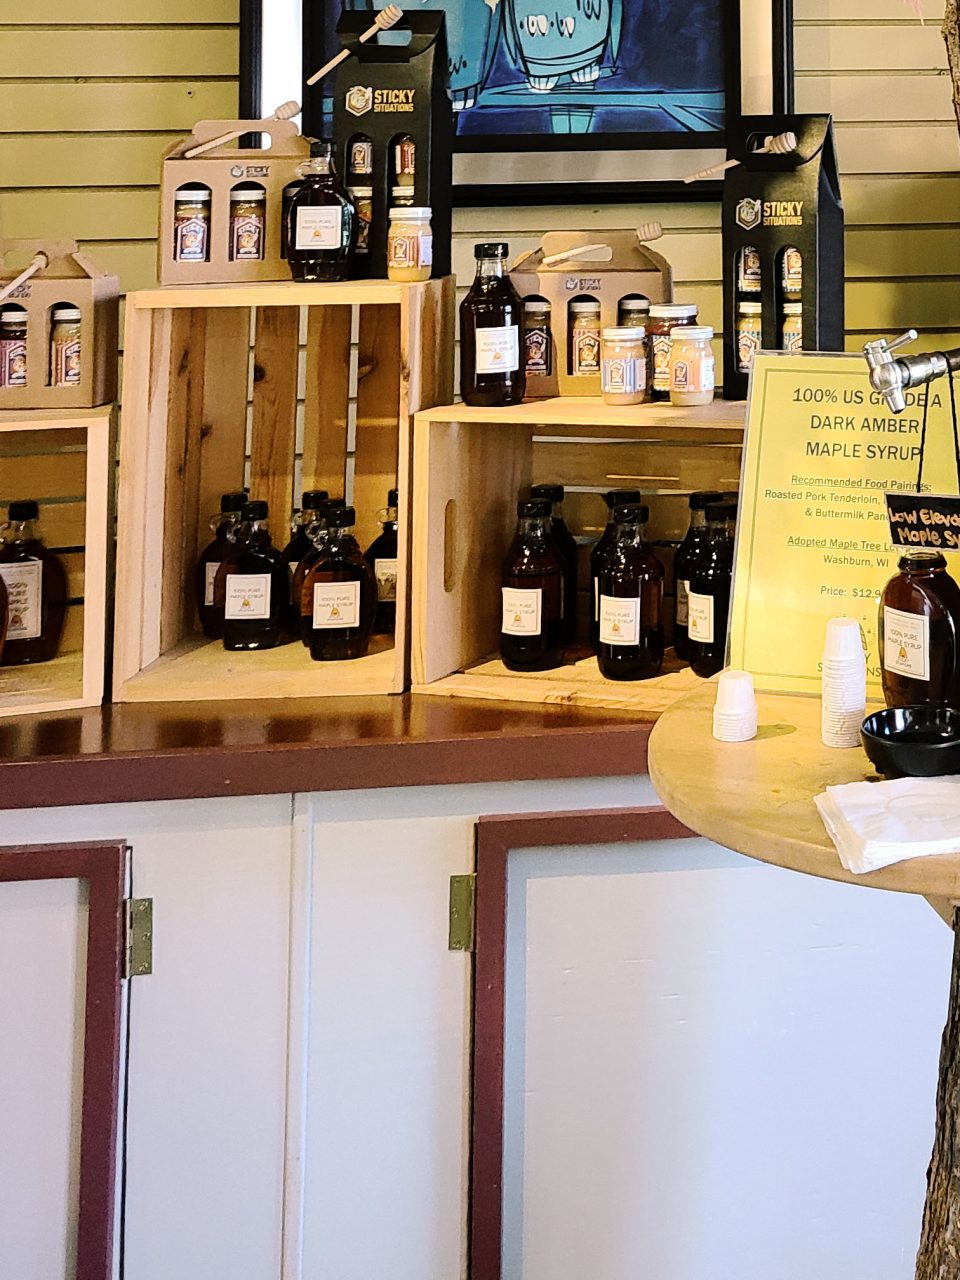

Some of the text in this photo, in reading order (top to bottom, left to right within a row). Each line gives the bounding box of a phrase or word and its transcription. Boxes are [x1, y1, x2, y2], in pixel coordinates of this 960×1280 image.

[374, 90, 415, 103] STICKY
[763, 202, 803, 216] STICKY
[792, 388, 942, 408] 100% US GDE A
[810, 415, 920, 433] DARK AMBER
[806, 442, 921, 460] MAPLE SYRUP
[791, 474, 862, 487] Recommended
[865, 479, 888, 488] Food
[765, 490, 802, 500] Roasted
[805, 492, 827, 501] Pork
[830, 494, 880, 504] Tenderloin,
[805, 508, 812, 516] &
[816, 508, 864, 520] Buttermilk
[787, 535, 827, 547] Adopted
[830, 538, 858, 550] Maple
[861, 541, 881, 550] Tree
[898, 527, 941, 546] Maple
[824, 555, 889, 568] Washburn, WI
[820, 586, 881, 599] Price: $12.9
